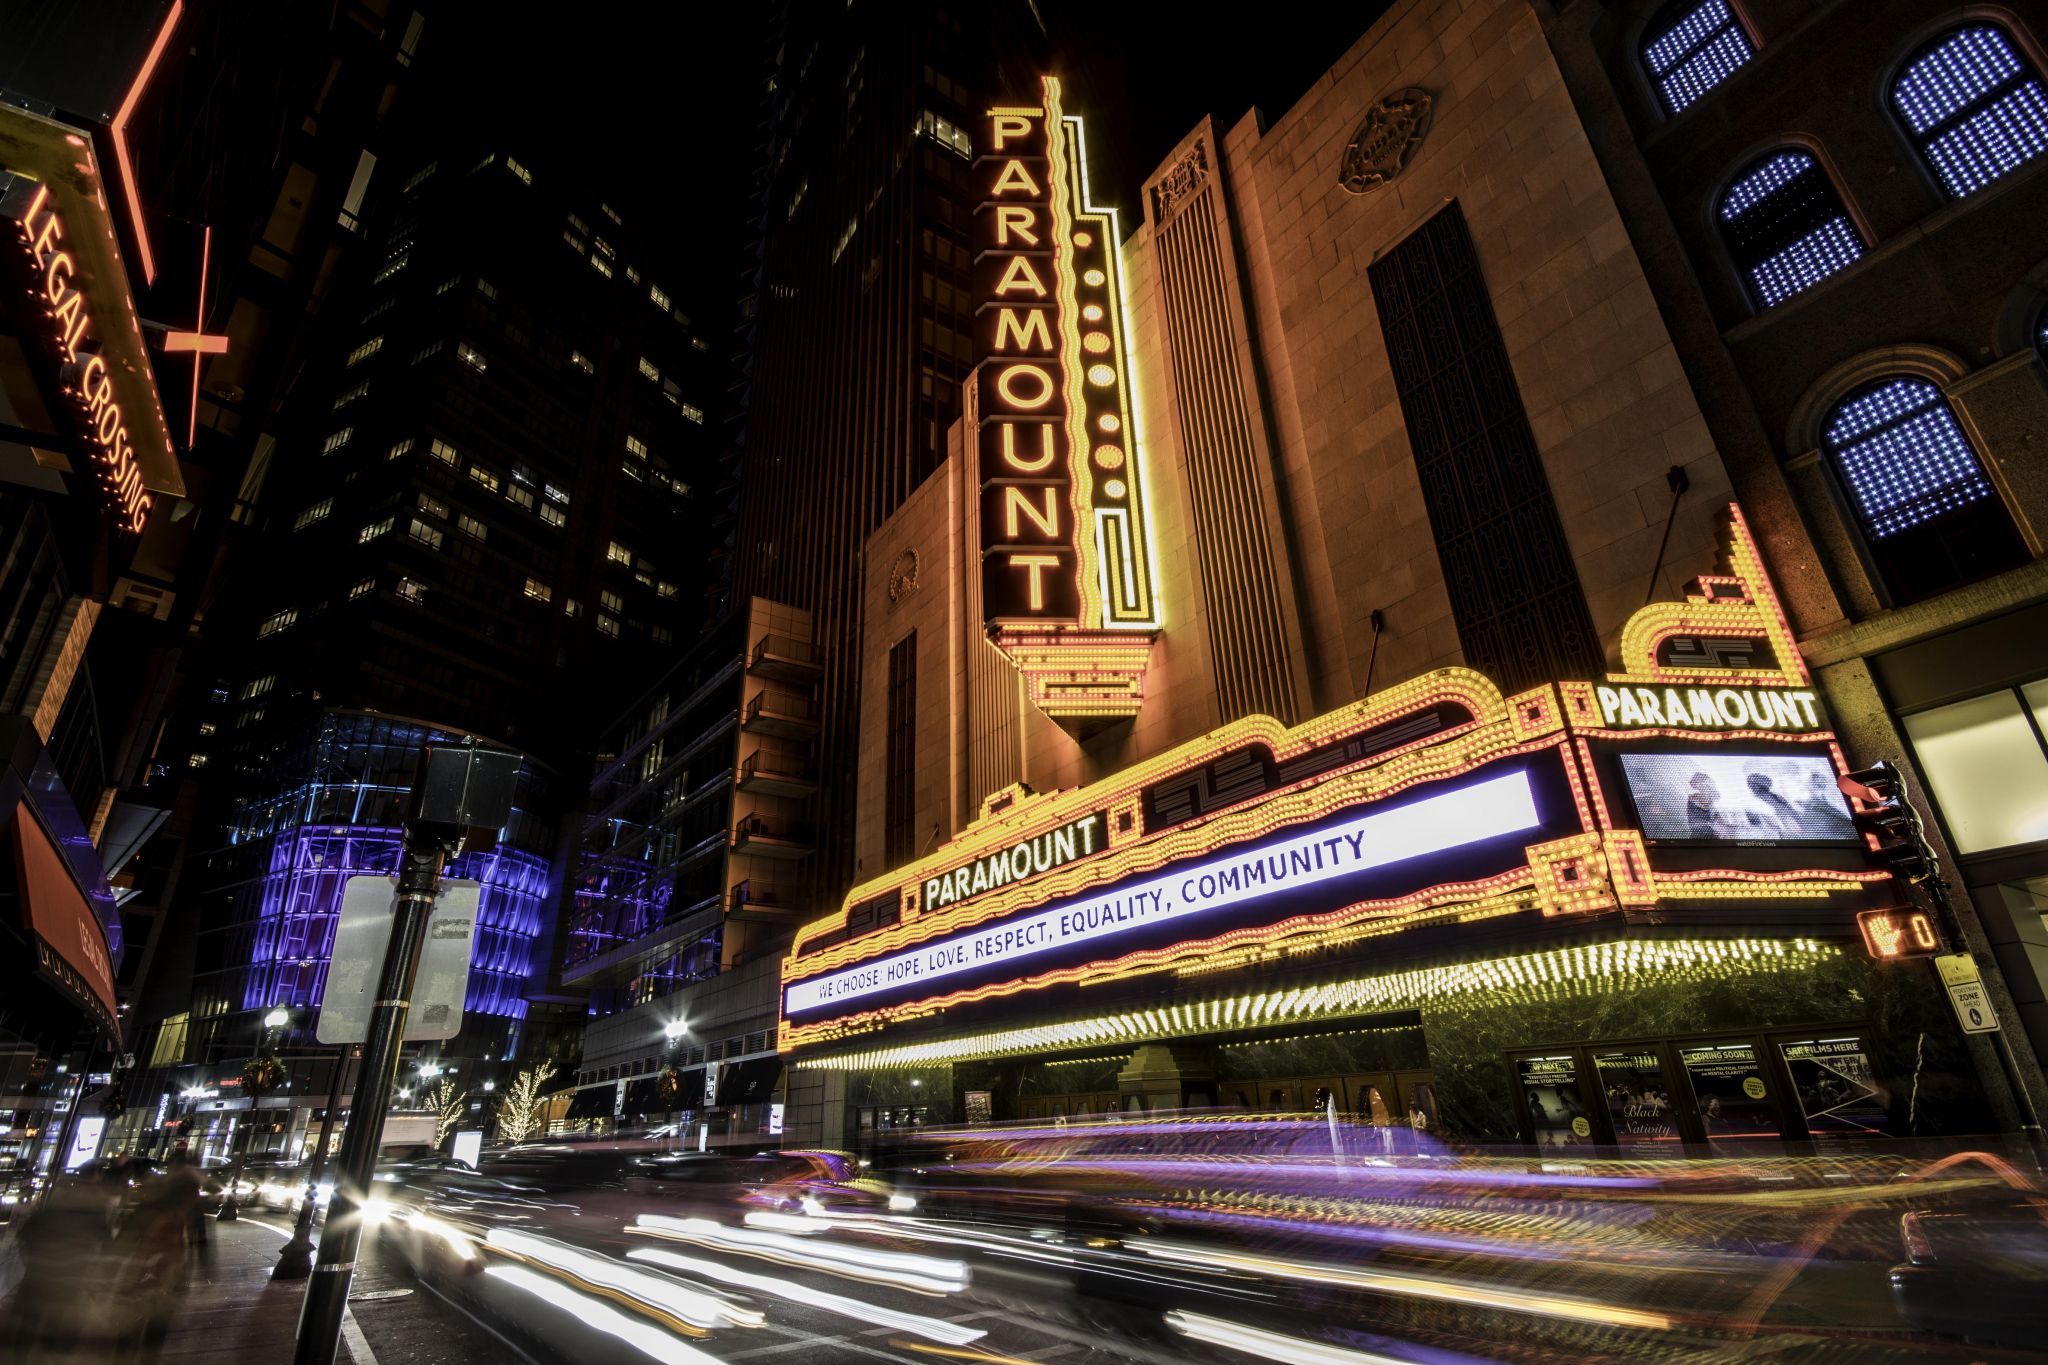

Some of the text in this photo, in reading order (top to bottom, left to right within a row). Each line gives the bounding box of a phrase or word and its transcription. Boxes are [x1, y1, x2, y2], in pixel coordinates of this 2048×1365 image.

[24, 185, 152, 534] LEGAL CROSSING
[992, 115, 1059, 611] PARAMOUNT
[1597, 686, 1819, 729] PARAMOUNT
[925, 814, 1097, 912] PARAMOUNT
[818, 984, 834, 999] WE
[887, 957, 925, 982] HOPE,
[929, 945, 970, 971] LOVE,
[975, 920, 1053, 957] RESPECT,
[1061, 887, 1173, 937] EQUALITY,
[1181, 829, 1366, 904] COMMUNITY
[1958, 992, 1980, 1002] ZONE
[1963, 1000, 1981, 1008] AHEAD
[1692, 1051, 1746, 1060] COMING SOON
[1785, 1042, 1860, 1055] SEE FILMS HERE
[1532, 1062, 1560, 1071] UP NEXT
[1623, 1103, 1660, 1119] Black
[1620, 1120, 1672, 1138] Nativity
